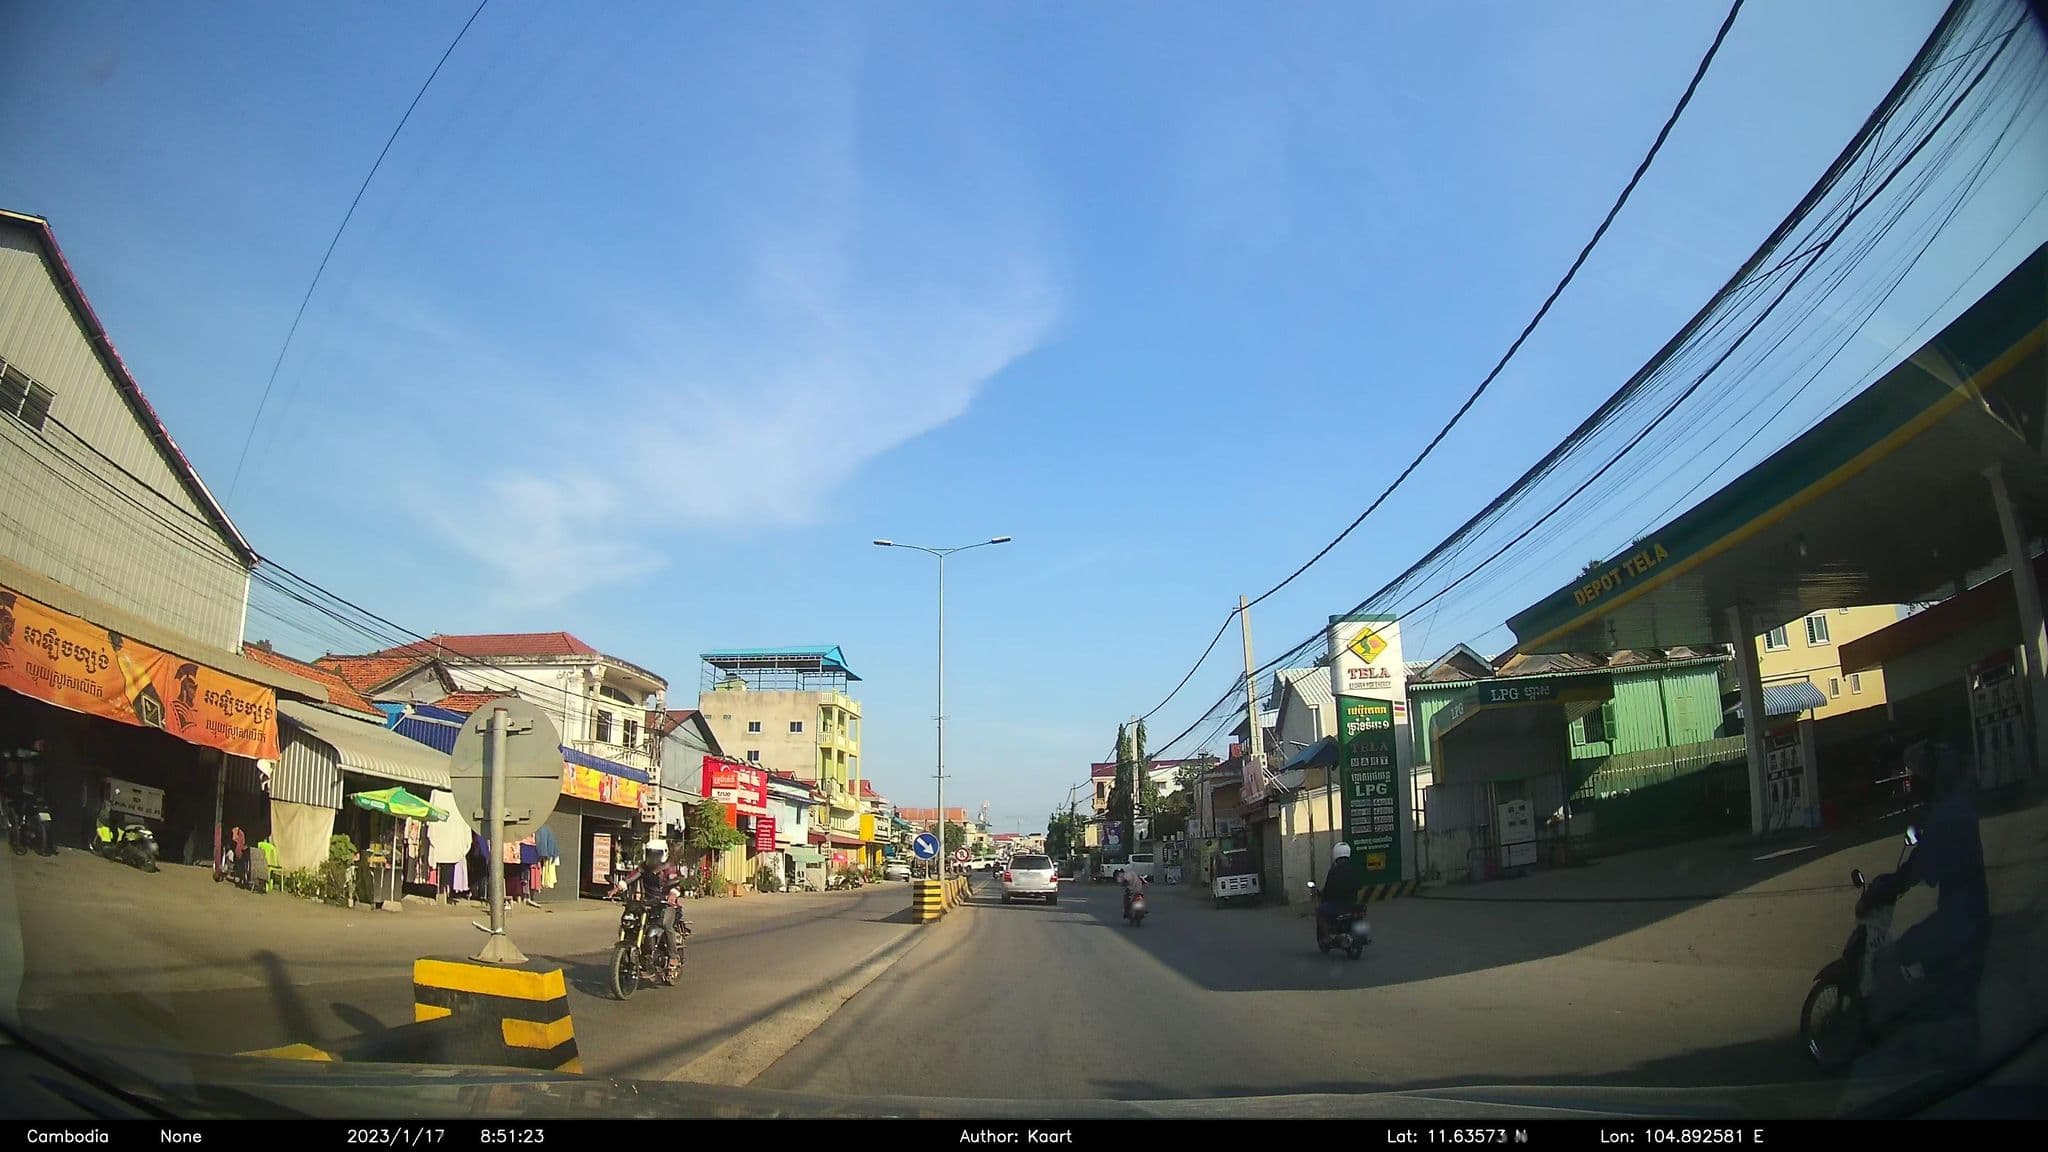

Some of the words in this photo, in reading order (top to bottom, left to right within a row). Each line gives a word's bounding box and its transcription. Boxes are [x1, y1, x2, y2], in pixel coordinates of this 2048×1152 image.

[1573, 567, 1622, 607] DEPOT
[1623, 543, 1669, 577] TELA
[1347, 667, 1391, 679] TELA
[1490, 687, 1519, 701] LPG
[1450, 702, 1464, 720] LPG
[1351, 742, 1389, 753] TELA
[1350, 756, 1389, 767] MART
[1355, 783, 1388, 797] LPG
[1600, 790, 1618, 799] WC
